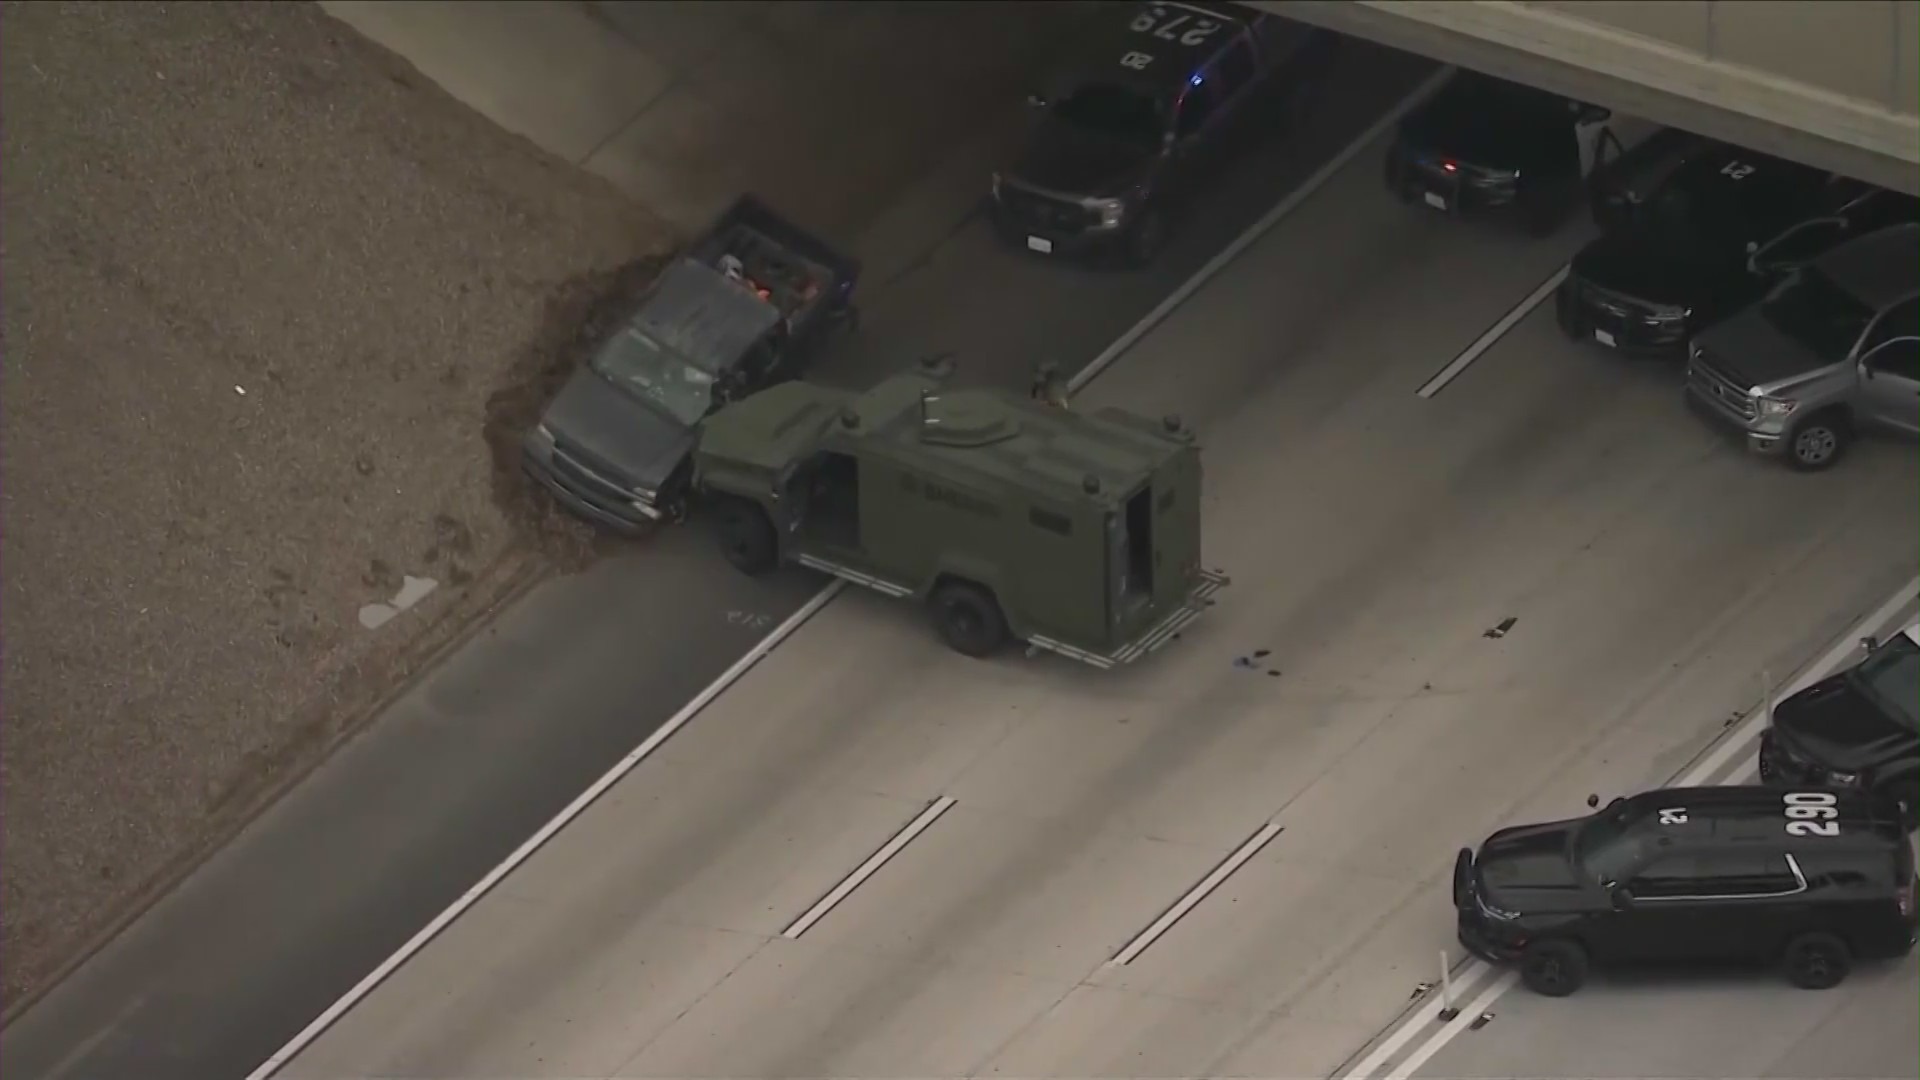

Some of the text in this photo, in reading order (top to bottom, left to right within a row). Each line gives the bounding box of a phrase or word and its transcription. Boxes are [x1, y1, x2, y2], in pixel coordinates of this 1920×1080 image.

[1129, 7, 1222, 46] 279
[1120, 51, 1154, 70] 20
[1720, 160, 1756, 180] 21
[1658, 807, 1689, 824] 21
[1783, 793, 1841, 836] 290
